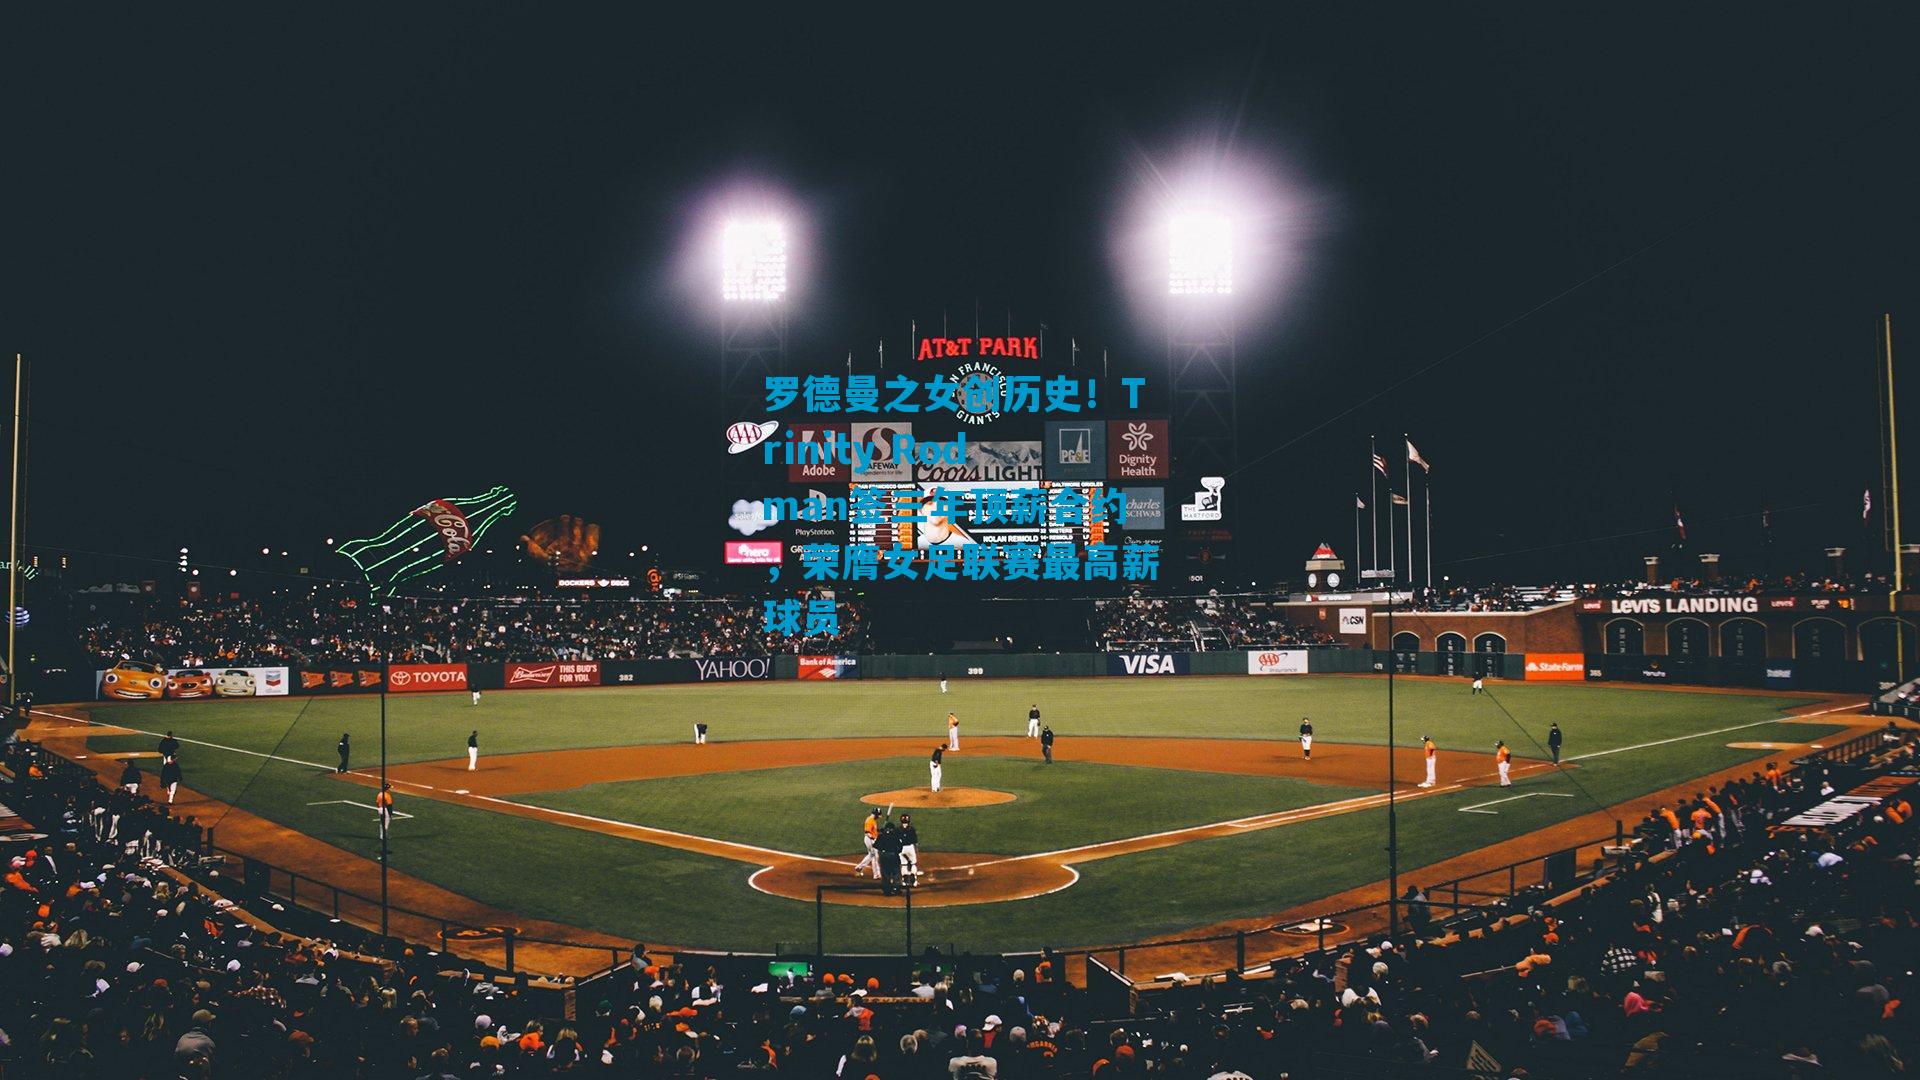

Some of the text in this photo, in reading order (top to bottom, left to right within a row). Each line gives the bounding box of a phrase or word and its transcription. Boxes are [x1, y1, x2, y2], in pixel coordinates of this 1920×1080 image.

[918, 337, 1038, 360] AT&T PARK
[956, 409, 1000, 425] GIANTS
[1119, 454, 1157, 466] Dignity
[802, 464, 836, 476] Adobe
[867, 462, 899, 470] AFEWAY
[915, 454, 1043, 481] Coors LIGHT
[1121, 467, 1156, 476] Health
[1126, 499, 1160, 509] charles
[795, 529, 835, 537] PlayStation
[1666, 598, 1758, 613] LANDING
[1350, 616, 1364, 624] CSN
[559, 664, 597, 673] THIS BUD'S
[695, 658, 771, 680] YAHOO!
[1118, 655, 1175, 674] VISA
[1540, 663, 1583, 671] State Farm
[413, 671, 467, 682] TOYOTA
[514, 670, 552, 679] Budweiser
[559, 674, 590, 682] FOR YOU.
